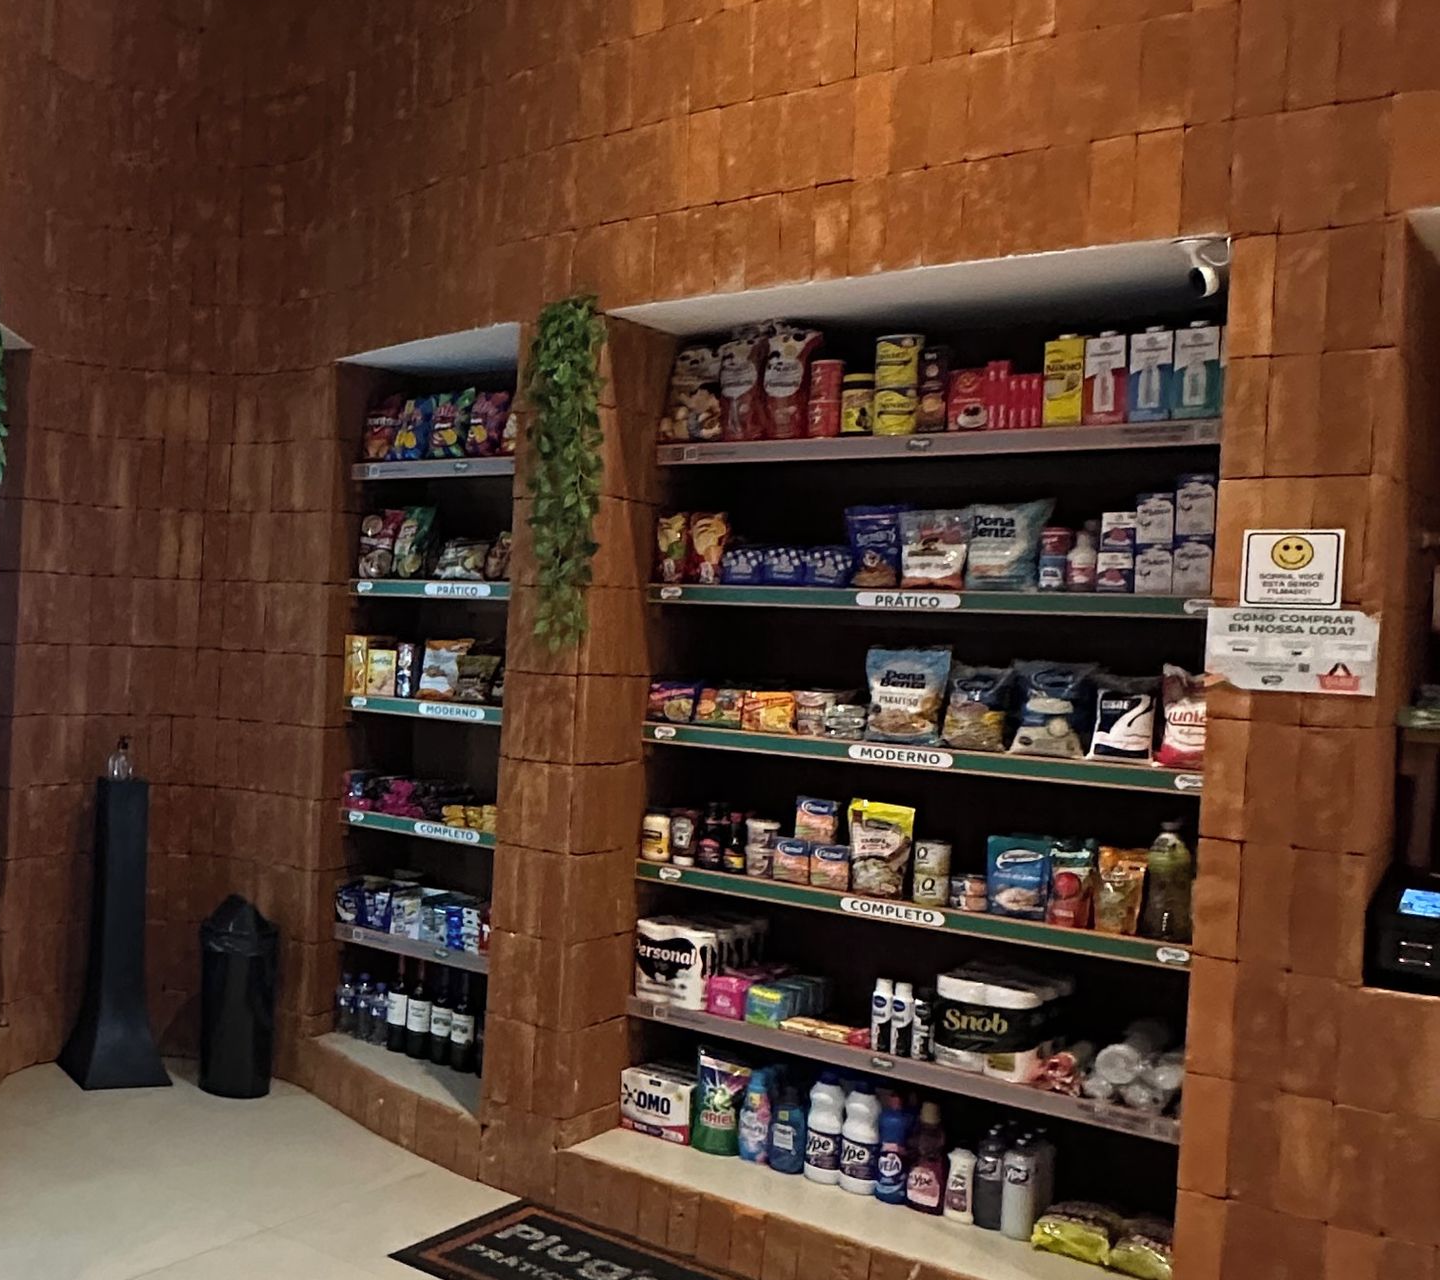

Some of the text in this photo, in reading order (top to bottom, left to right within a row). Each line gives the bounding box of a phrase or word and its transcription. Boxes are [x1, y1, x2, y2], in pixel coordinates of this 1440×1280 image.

[436, 583, 479, 597] PRÁTICO
[874, 592, 941, 608] PRÁTICO
[1232, 612, 1354, 625] COMO COMPRAR
[1228, 623, 1356, 636] EM NOSSA LOJA?
[886, 670, 925, 680] Dona
[880, 678, 926, 689] Benta
[426, 705, 478, 718] MODERNO
[859, 747, 940, 765] MODERNO
[420, 824, 474, 841] COMPLETO
[850, 899, 935, 923] COMPLETO
[943, 1008, 1009, 1036] Snob
[638, 1090, 671, 1115] OMO
